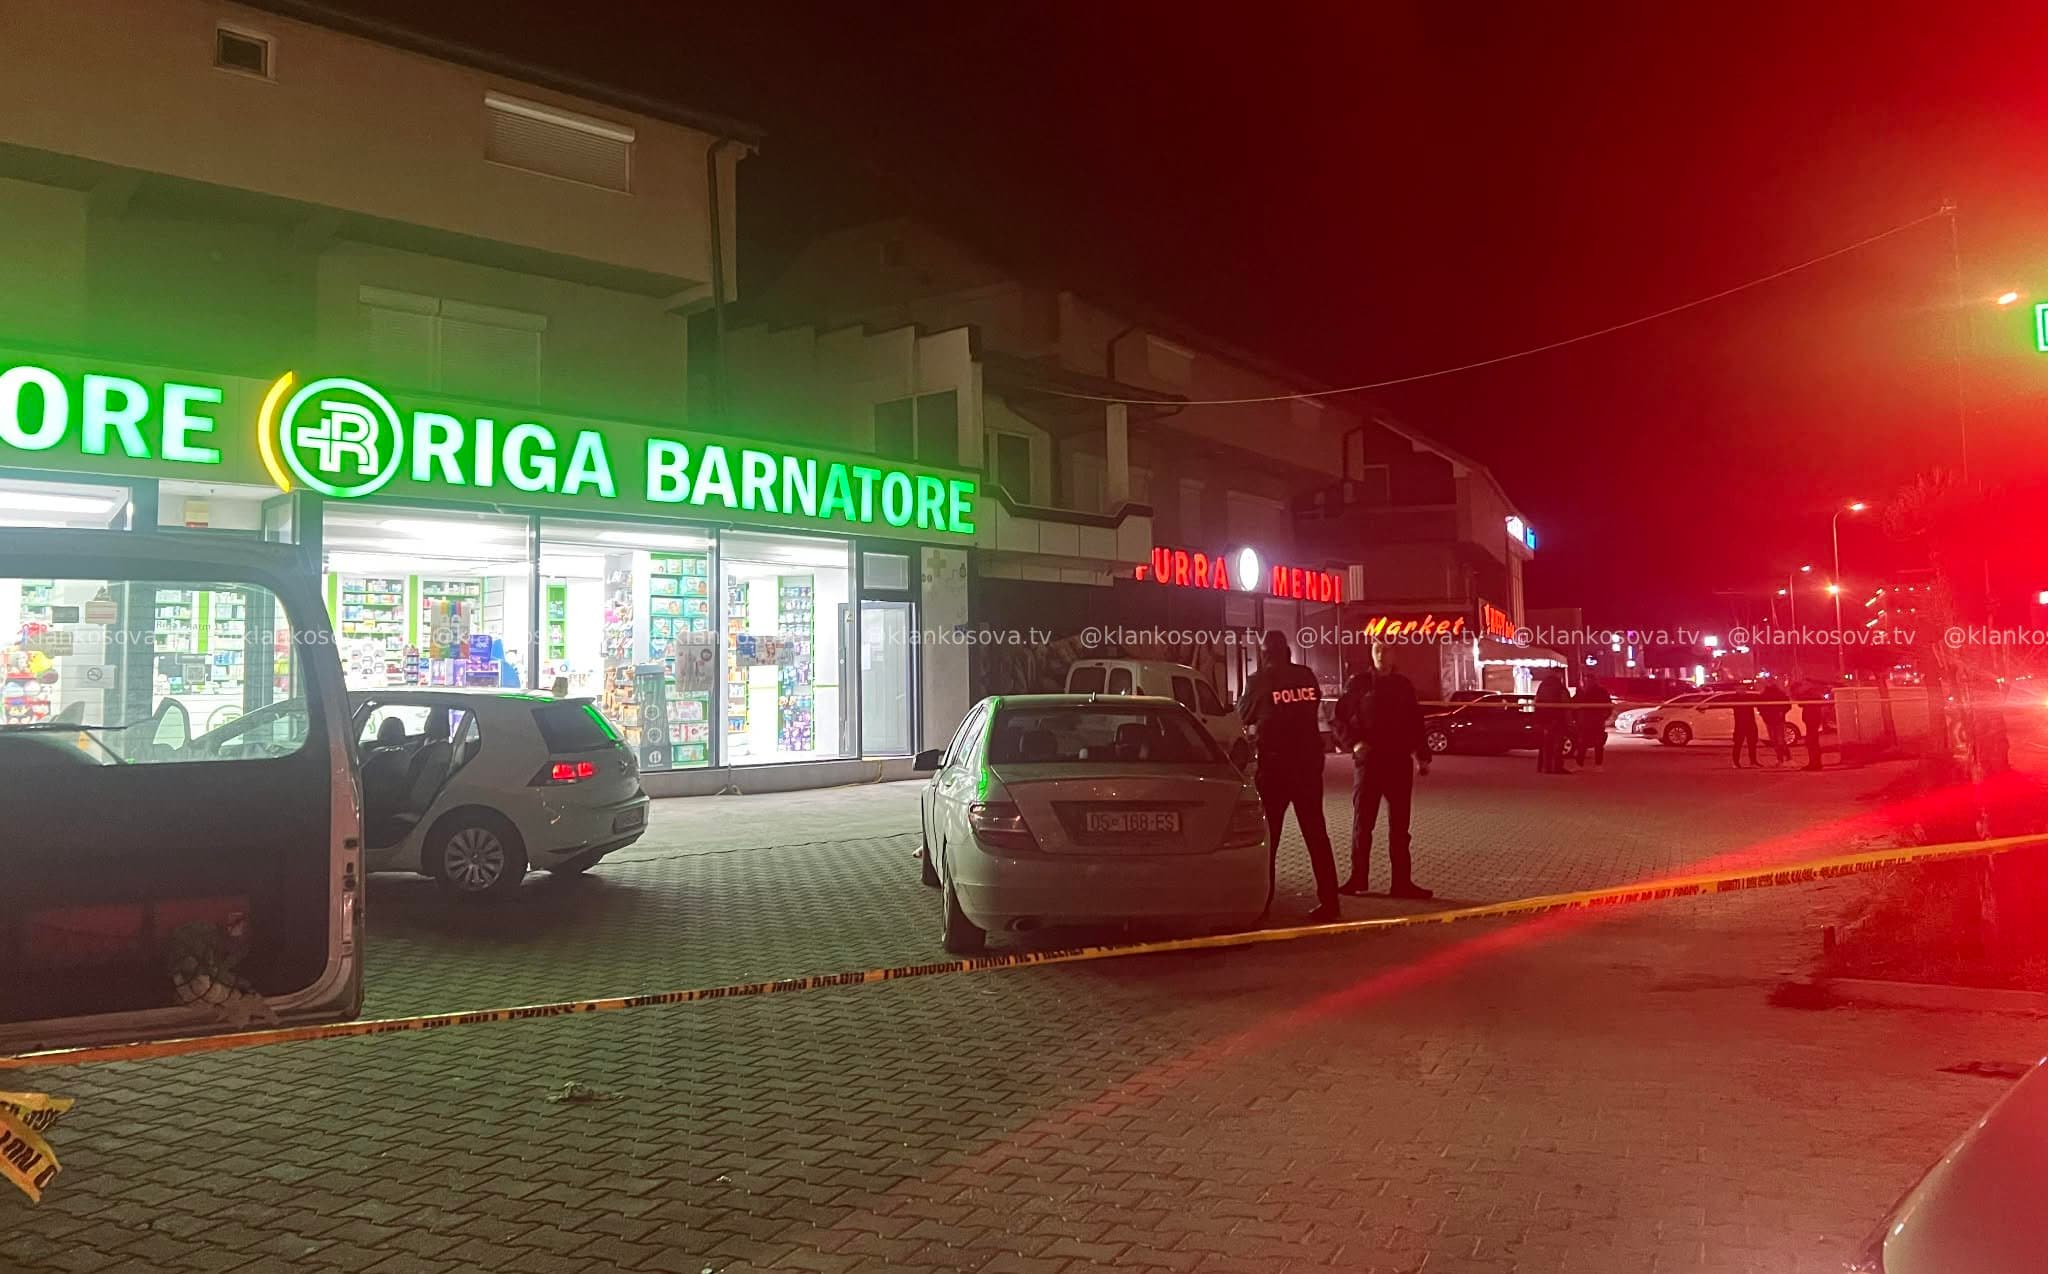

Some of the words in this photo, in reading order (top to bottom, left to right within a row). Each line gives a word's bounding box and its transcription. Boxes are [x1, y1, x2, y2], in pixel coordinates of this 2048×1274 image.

[411, 411, 617, 498] RIGA
[646, 438, 976, 534] BARNATORE
[1272, 565, 1342, 604] MENDI
[1363, 614, 1466, 637] Market
[1272, 687, 1317, 705] POLICE
